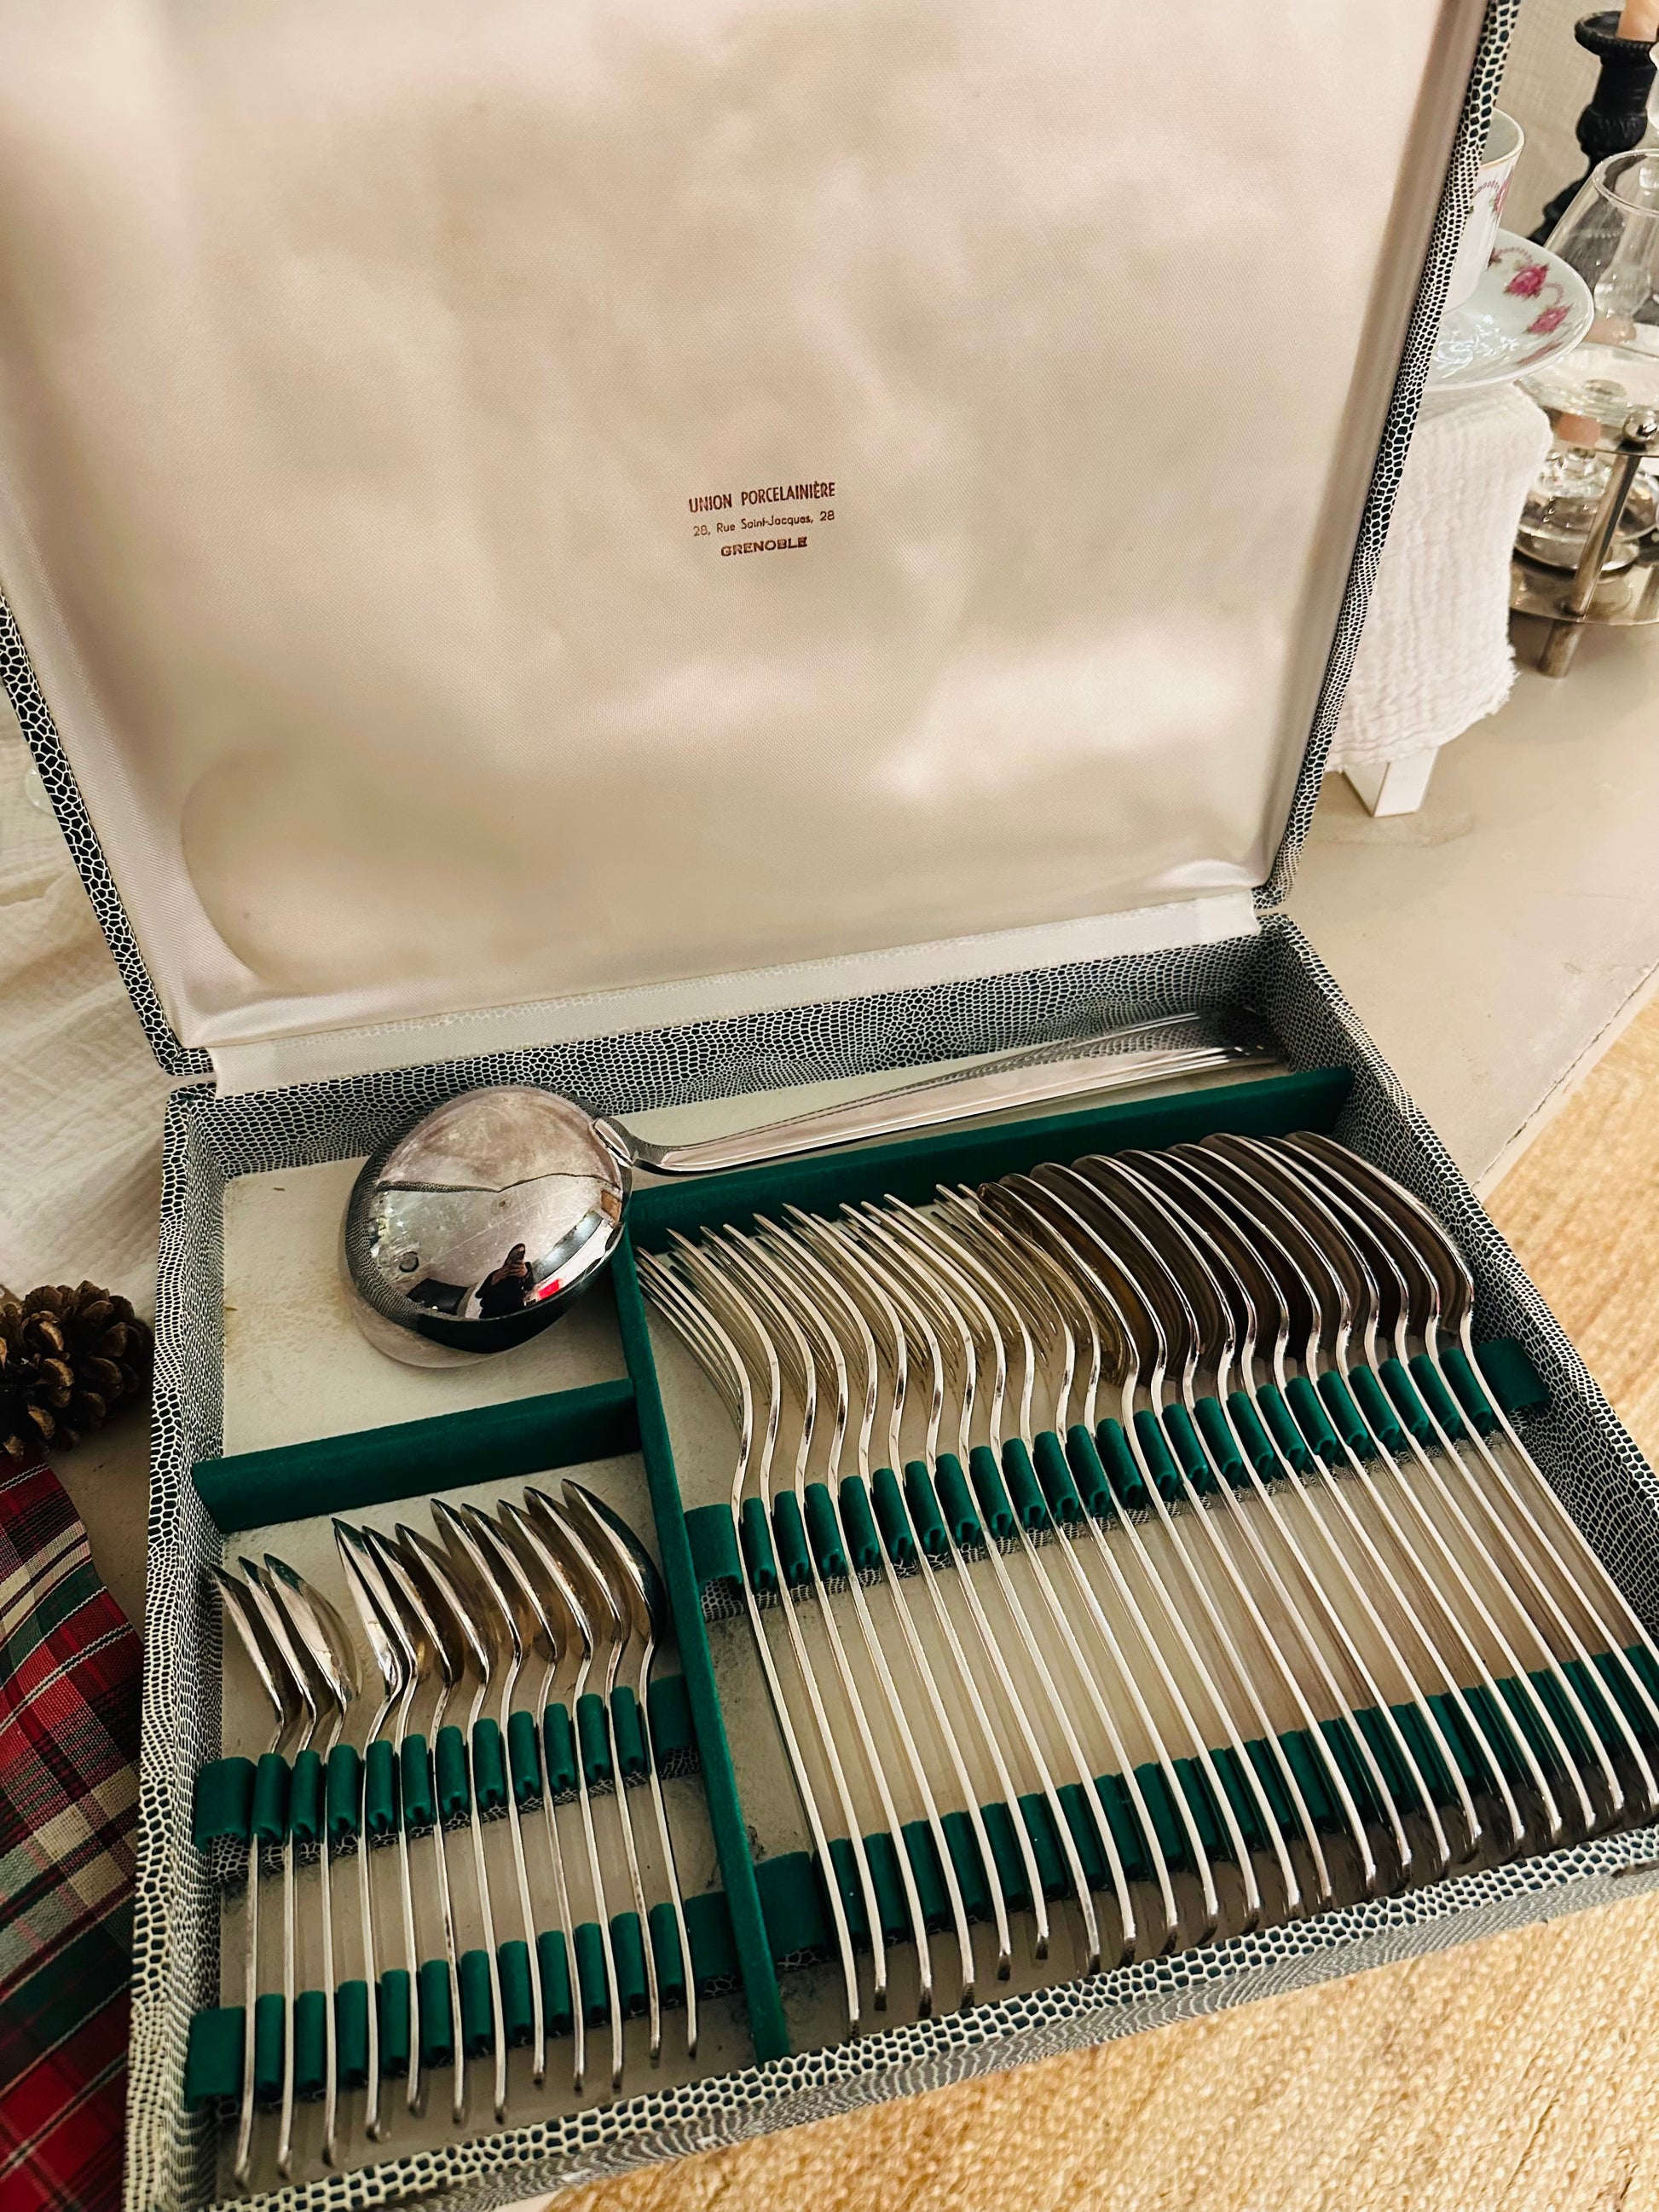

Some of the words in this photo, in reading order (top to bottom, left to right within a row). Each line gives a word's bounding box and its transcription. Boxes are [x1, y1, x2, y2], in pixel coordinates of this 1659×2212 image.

[688, 494, 732, 512] UNION
[741, 481, 835, 505] PORCELAINIÈRE
[693, 524, 711, 537] 28,
[716, 523, 736, 533] Rue
[741, 515, 814, 529] Saint-Jacques,
[819, 510, 835, 522] 28
[720, 536, 808, 557] GRENOBLE
